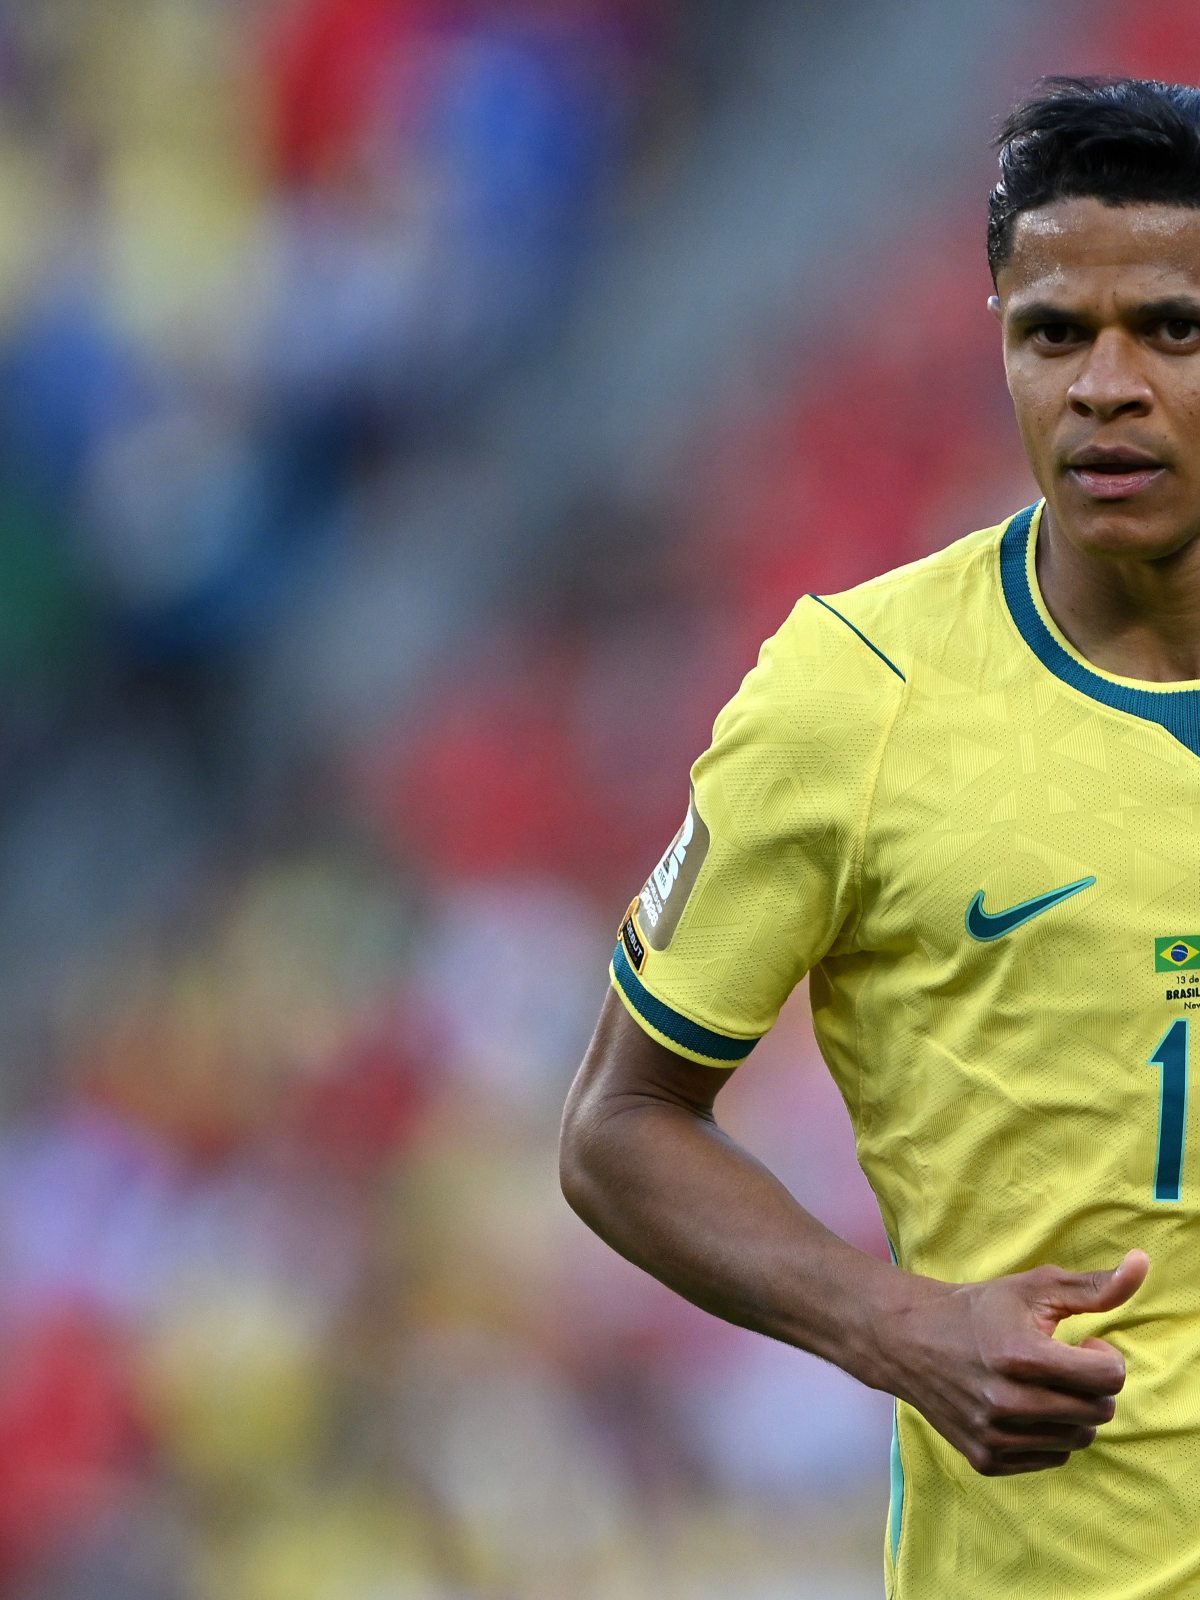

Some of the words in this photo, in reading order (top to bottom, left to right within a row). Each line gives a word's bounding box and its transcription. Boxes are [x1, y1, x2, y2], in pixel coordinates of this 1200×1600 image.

[626, 919, 644, 957] DEBUT
[1176, 976, 1186, 984] 13
[1189, 975, 1200, 983] de
[1166, 987, 1200, 1000] BRASIL
